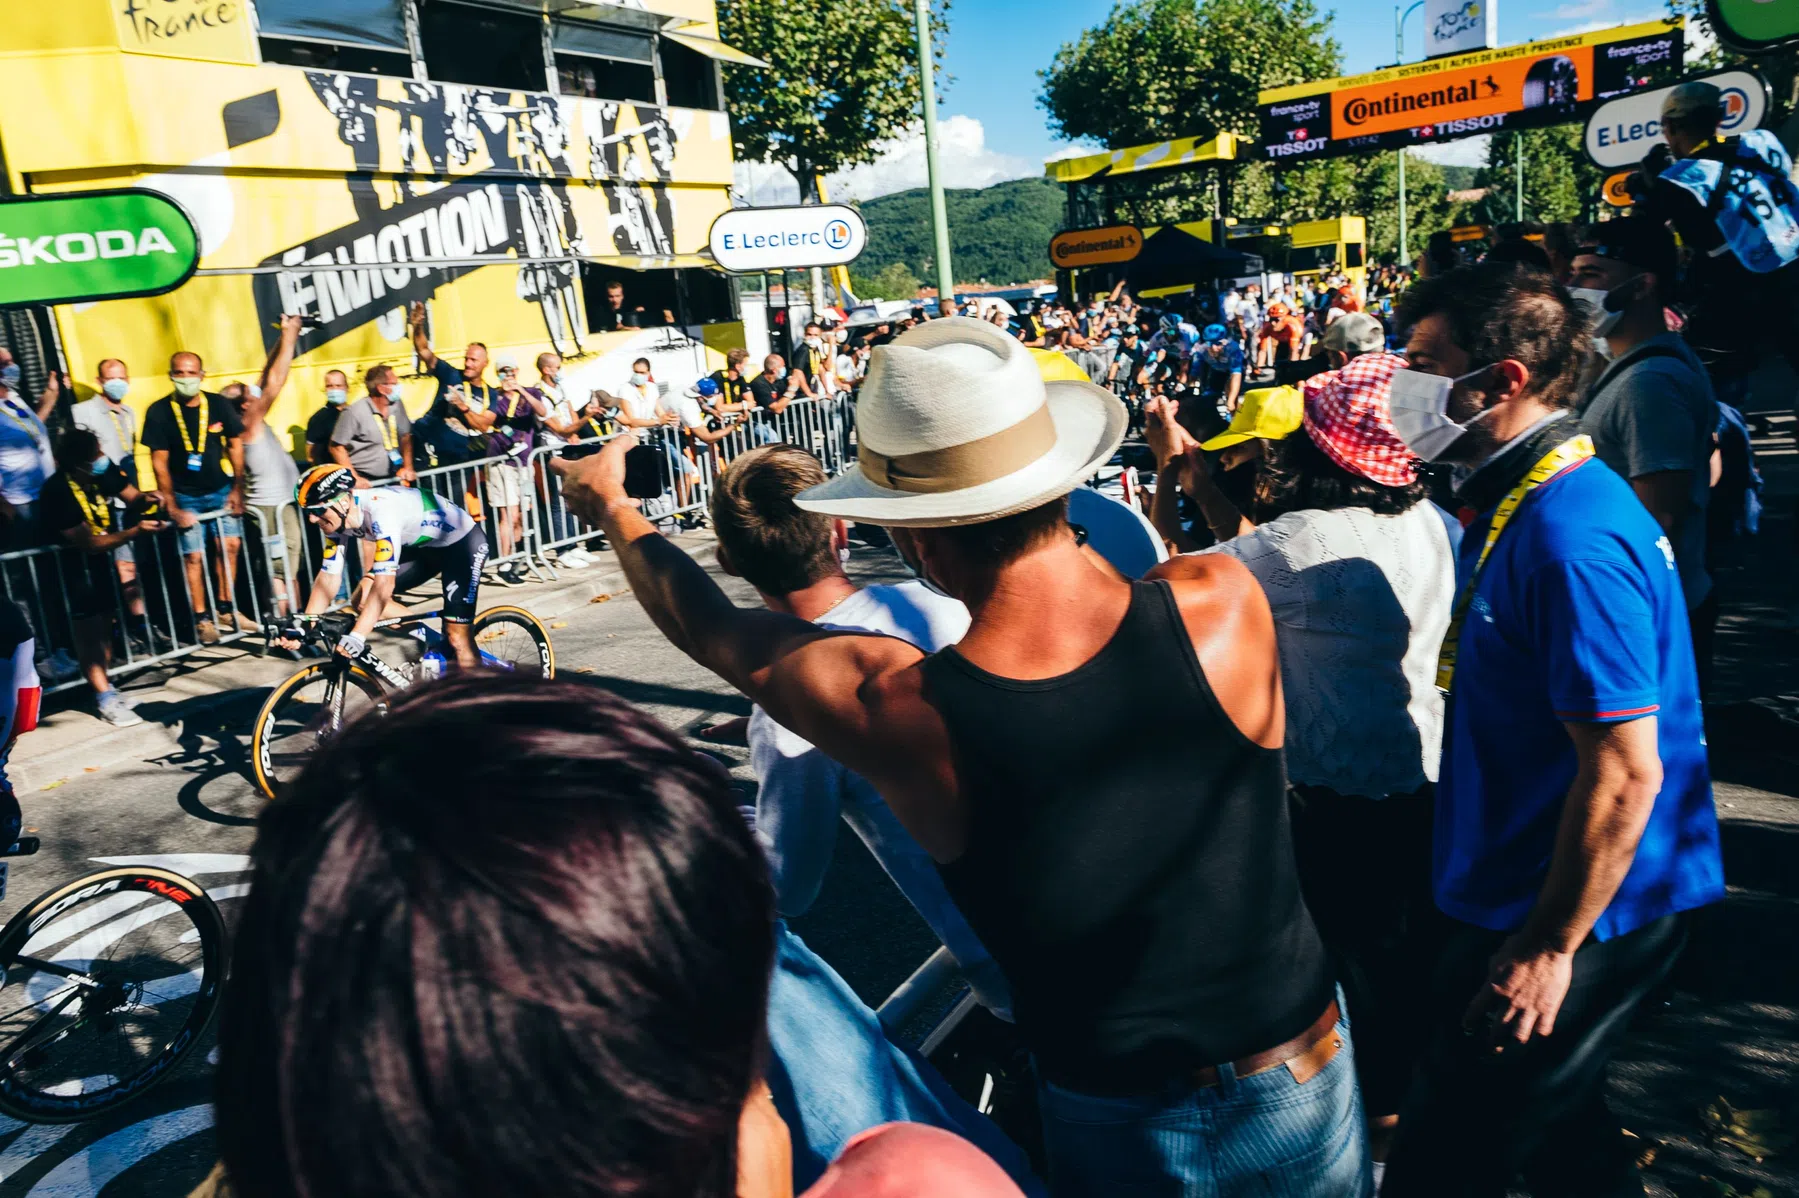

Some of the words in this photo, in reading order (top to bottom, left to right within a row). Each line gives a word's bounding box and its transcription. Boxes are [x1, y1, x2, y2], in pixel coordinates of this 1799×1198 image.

[1398, 63, 1440, 77] SISTERON
[1451, 57, 1478, 67] ALPES
[1481, 53, 1492, 62] DE
[1343, 79, 1477, 126] Continental
[1435, 112, 1508, 136] TISSOT
[1597, 119, 1663, 147] E.Lec
[1265, 136, 1328, 157] TISSOT
[0, 227, 177, 268] ŠKODA
[723, 231, 820, 250] E.Leclerc
[1056, 235, 1125, 259] Continental
[360, 652, 411, 691] S-WOR
[28, 879, 125, 935] BORA
